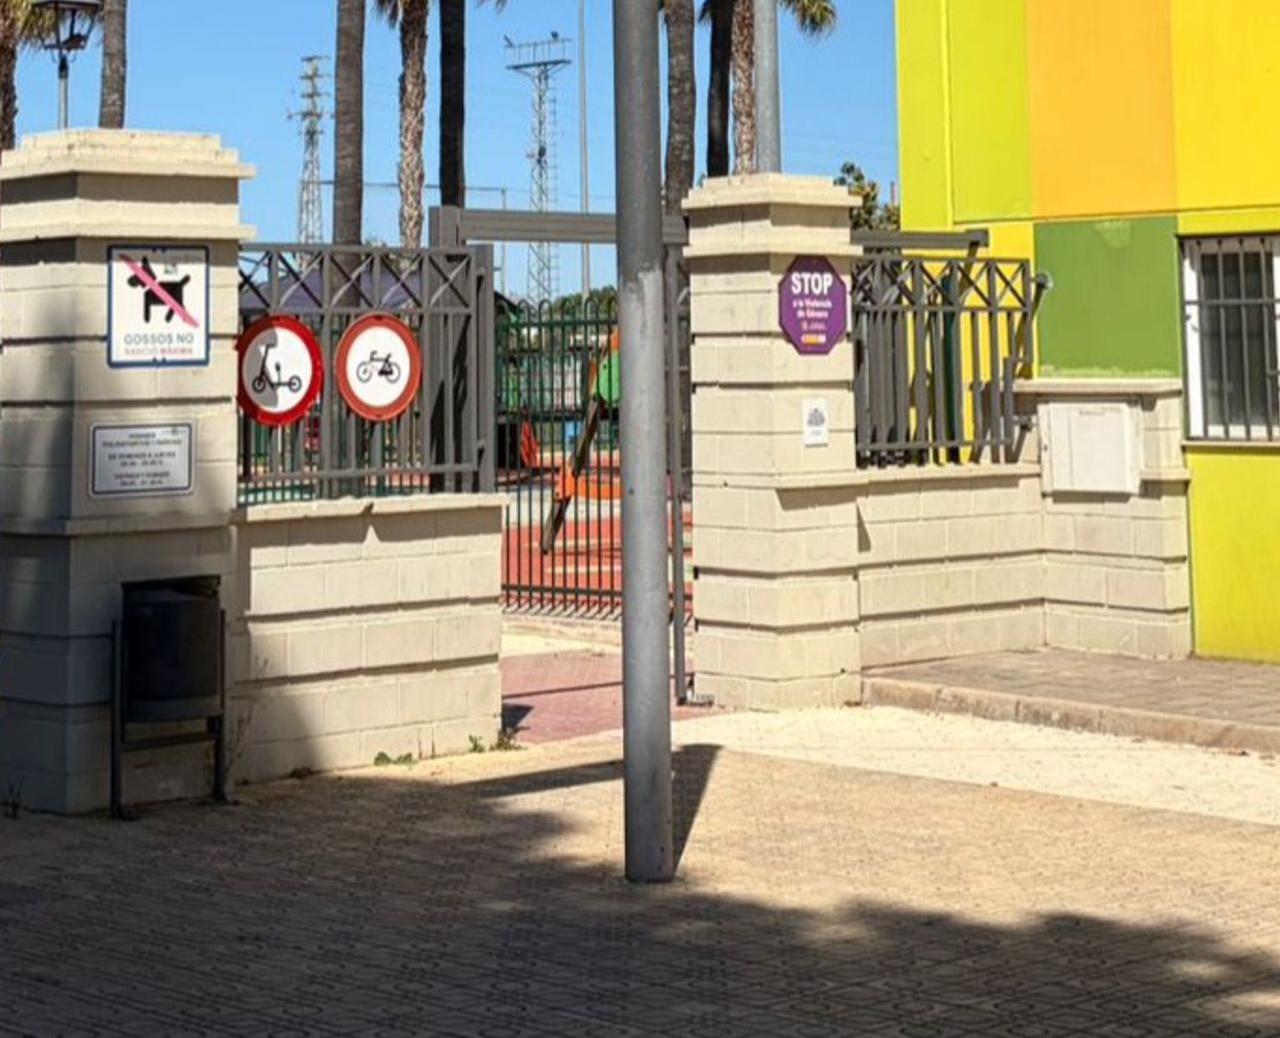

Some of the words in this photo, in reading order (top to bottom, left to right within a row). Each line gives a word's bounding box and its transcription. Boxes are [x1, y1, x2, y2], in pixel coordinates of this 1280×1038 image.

[791, 272, 834, 295] STOP
[123, 332, 174, 345] GOSSOS
[175, 331, 195, 344] NO
